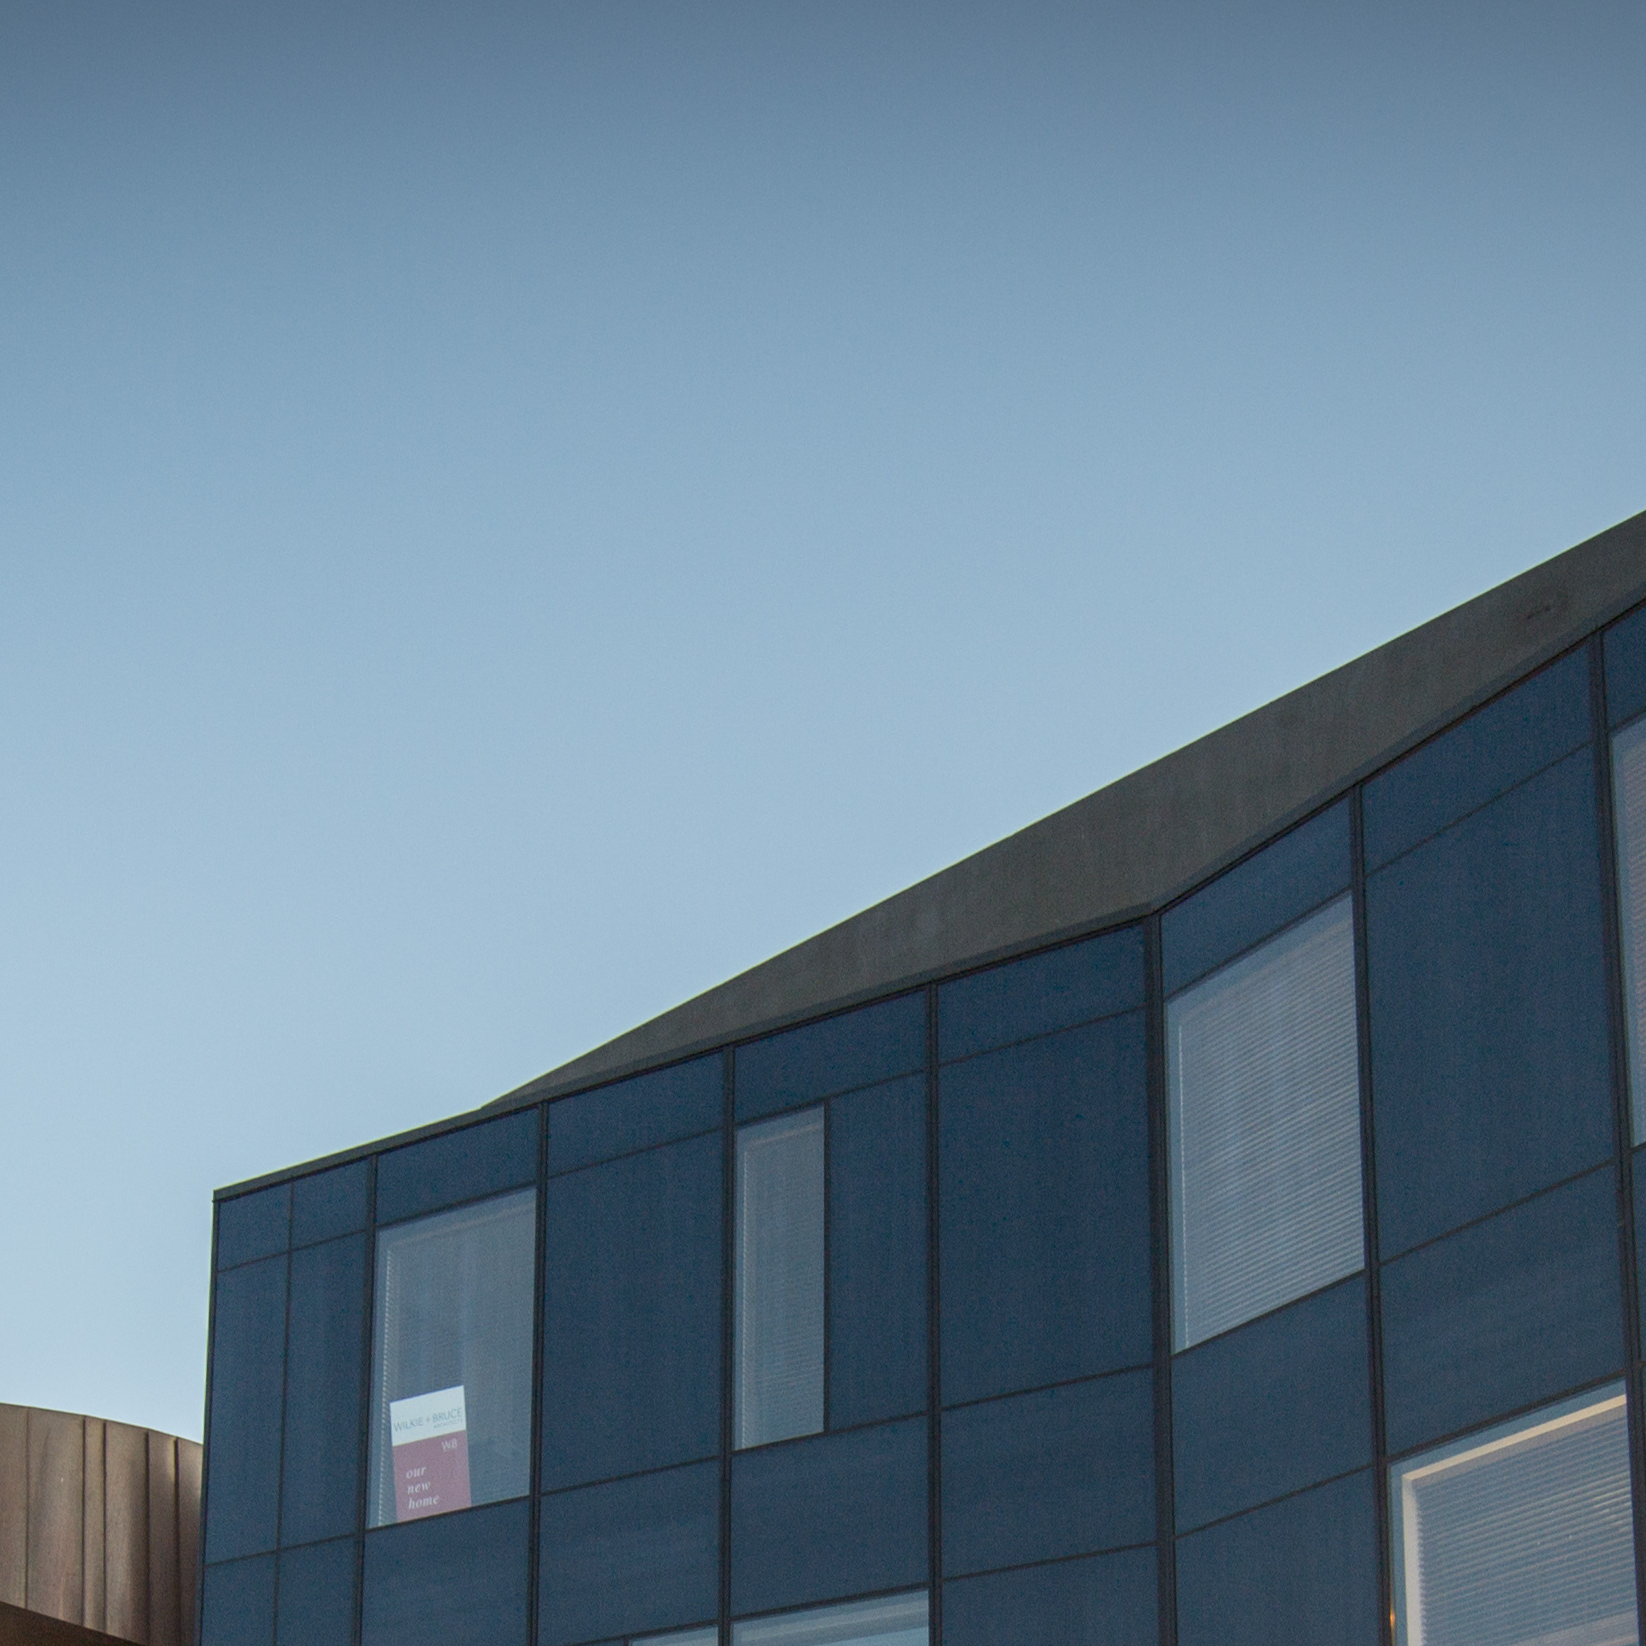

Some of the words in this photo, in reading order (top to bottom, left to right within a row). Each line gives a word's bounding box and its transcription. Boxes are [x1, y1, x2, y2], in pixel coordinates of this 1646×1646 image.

[394, 1417, 424, 1432] WILKIE
[432, 1408, 463, 1423] BRUCE
[406, 1466, 427, 1479] our
[407, 1481, 431, 1495] new
[408, 1494, 440, 1510] home
